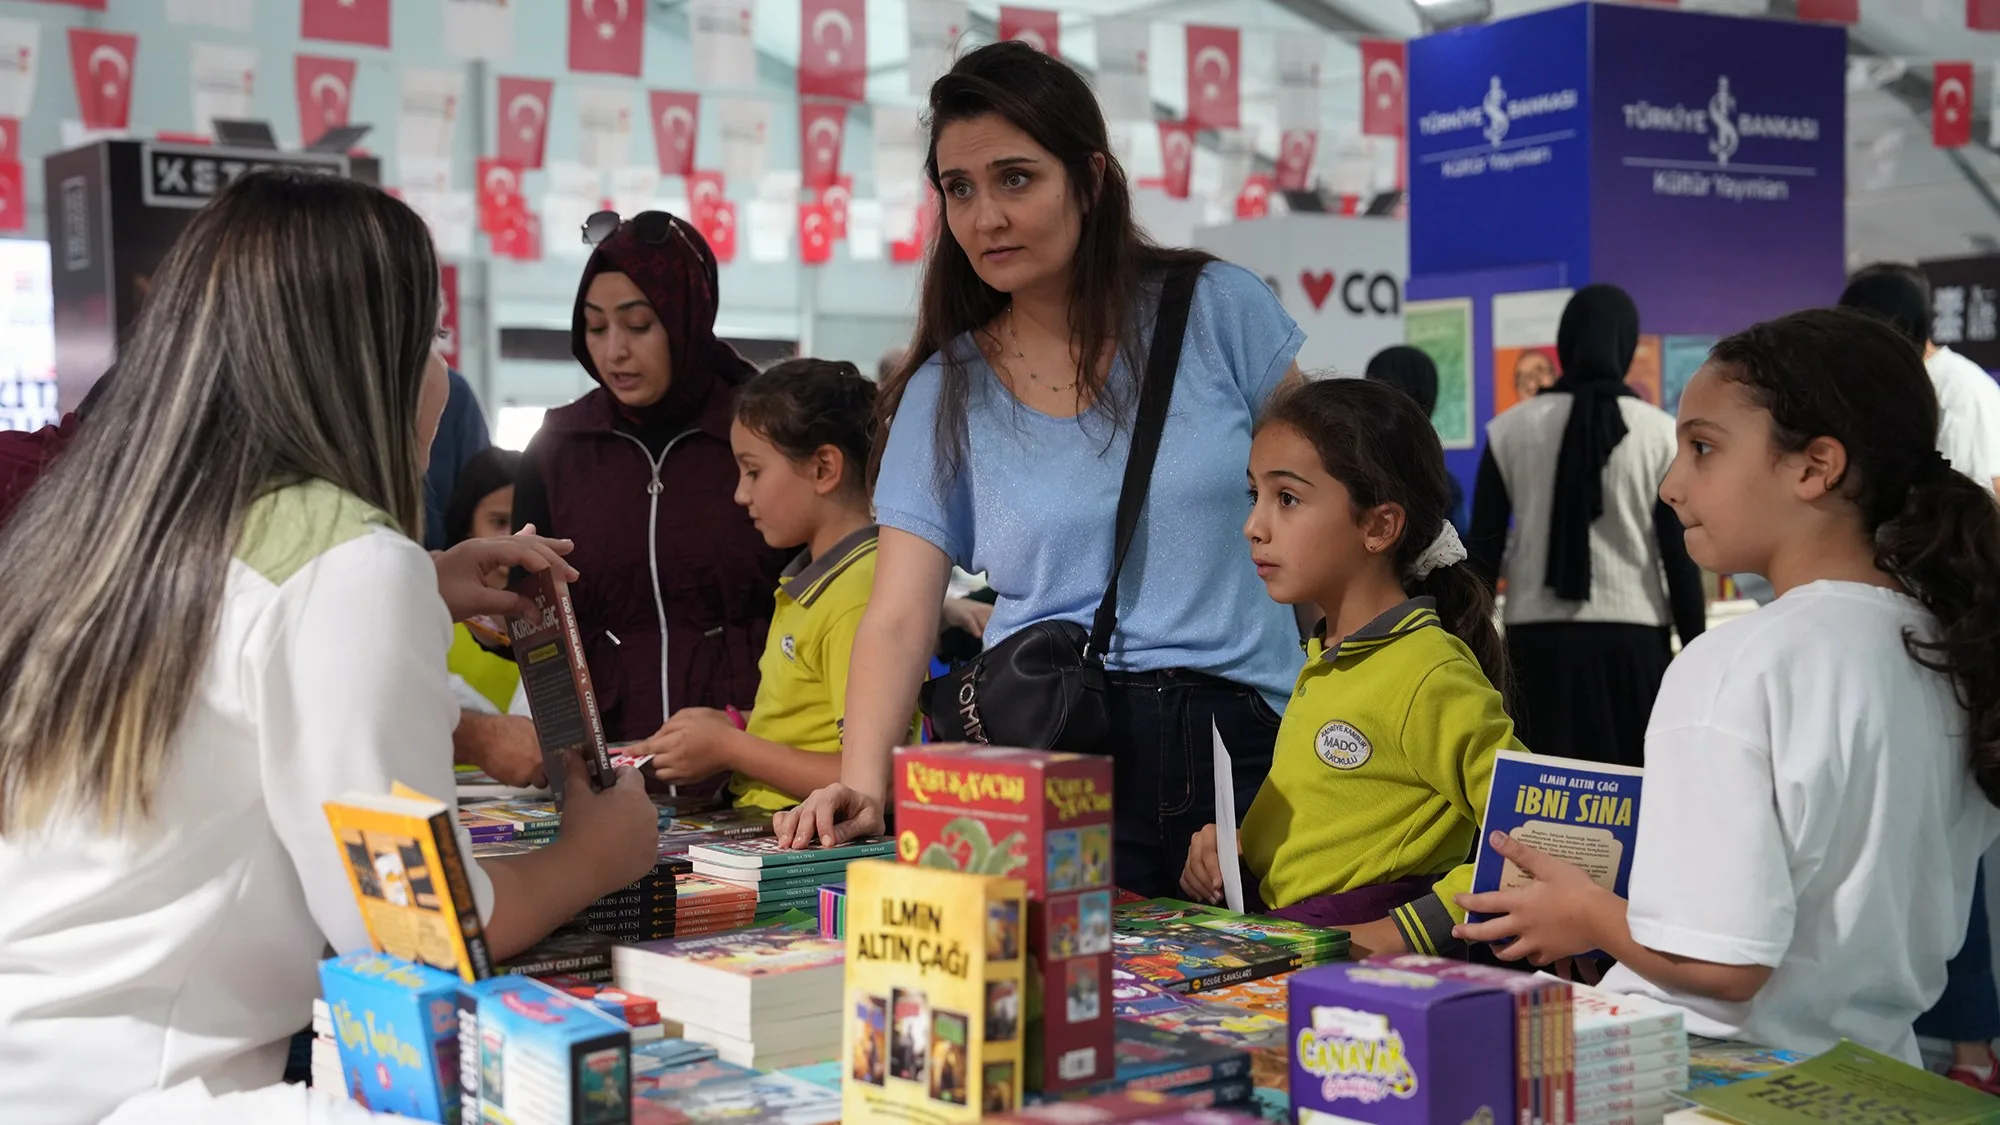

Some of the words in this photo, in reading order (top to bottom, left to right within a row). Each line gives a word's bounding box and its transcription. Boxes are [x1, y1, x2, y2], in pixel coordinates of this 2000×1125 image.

[1507, 89, 1578, 120] BANKASI
[1622, 99, 1708, 134] TÜRKİYE
[1738, 113, 1820, 140] BANKASI
[1652, 169, 1710, 197] Kültür
[1713, 173, 1789, 202] Yayınları
[1323, 736, 1358, 753] MADO
[1323, 750, 1358, 765] İLKOKULU
[1539, 773, 1566, 787] İLMİN
[1568, 778, 1595, 790] ALTIN
[1597, 781, 1620, 793] ÇAĞI
[1515, 785, 1570, 820] İBNİ
[1575, 793, 1632, 827] SİNA
[618, 907, 641, 917] ATEŞİ
[619, 895, 641, 905] ATEŞİ
[618, 921, 640, 930] ATEŞİ
[882, 898, 944, 933] İLMİN
[857, 933, 912, 962] ALTIN
[916, 938, 970, 979] ÇAĞI
